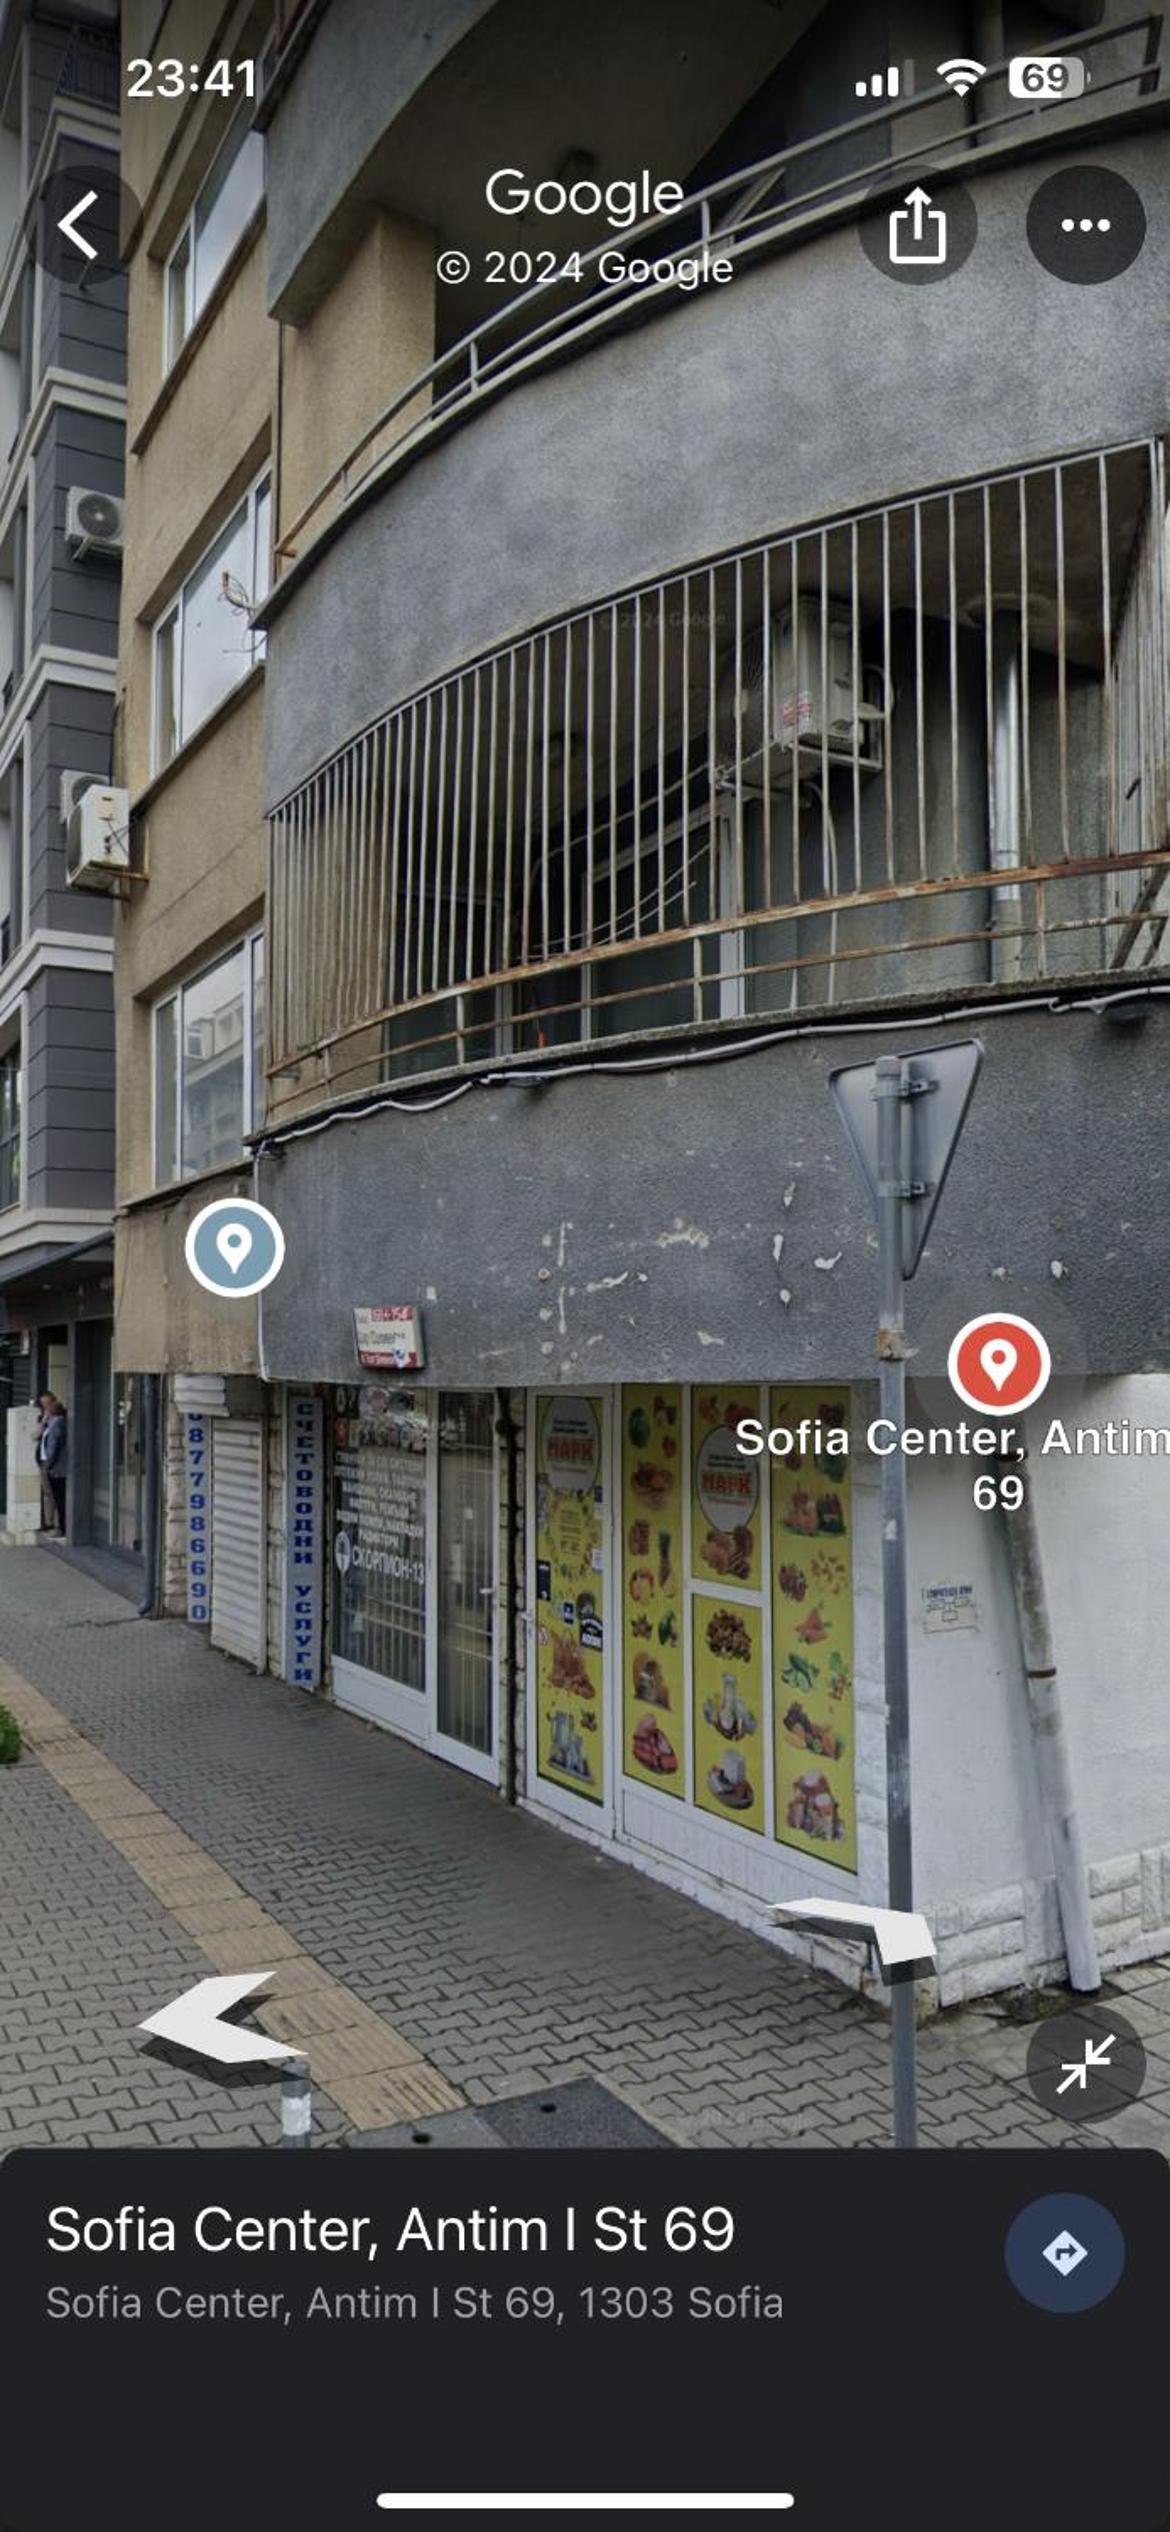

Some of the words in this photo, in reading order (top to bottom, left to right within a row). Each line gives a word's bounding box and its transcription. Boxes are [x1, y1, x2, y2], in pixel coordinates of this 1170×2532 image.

[294, 1403, 315, 1564] СЧЕТОВОДНИ
[352, 1545, 425, 1586] СКОРПИОН-13
[294, 1585, 313, 1681] УСЛУГИ
